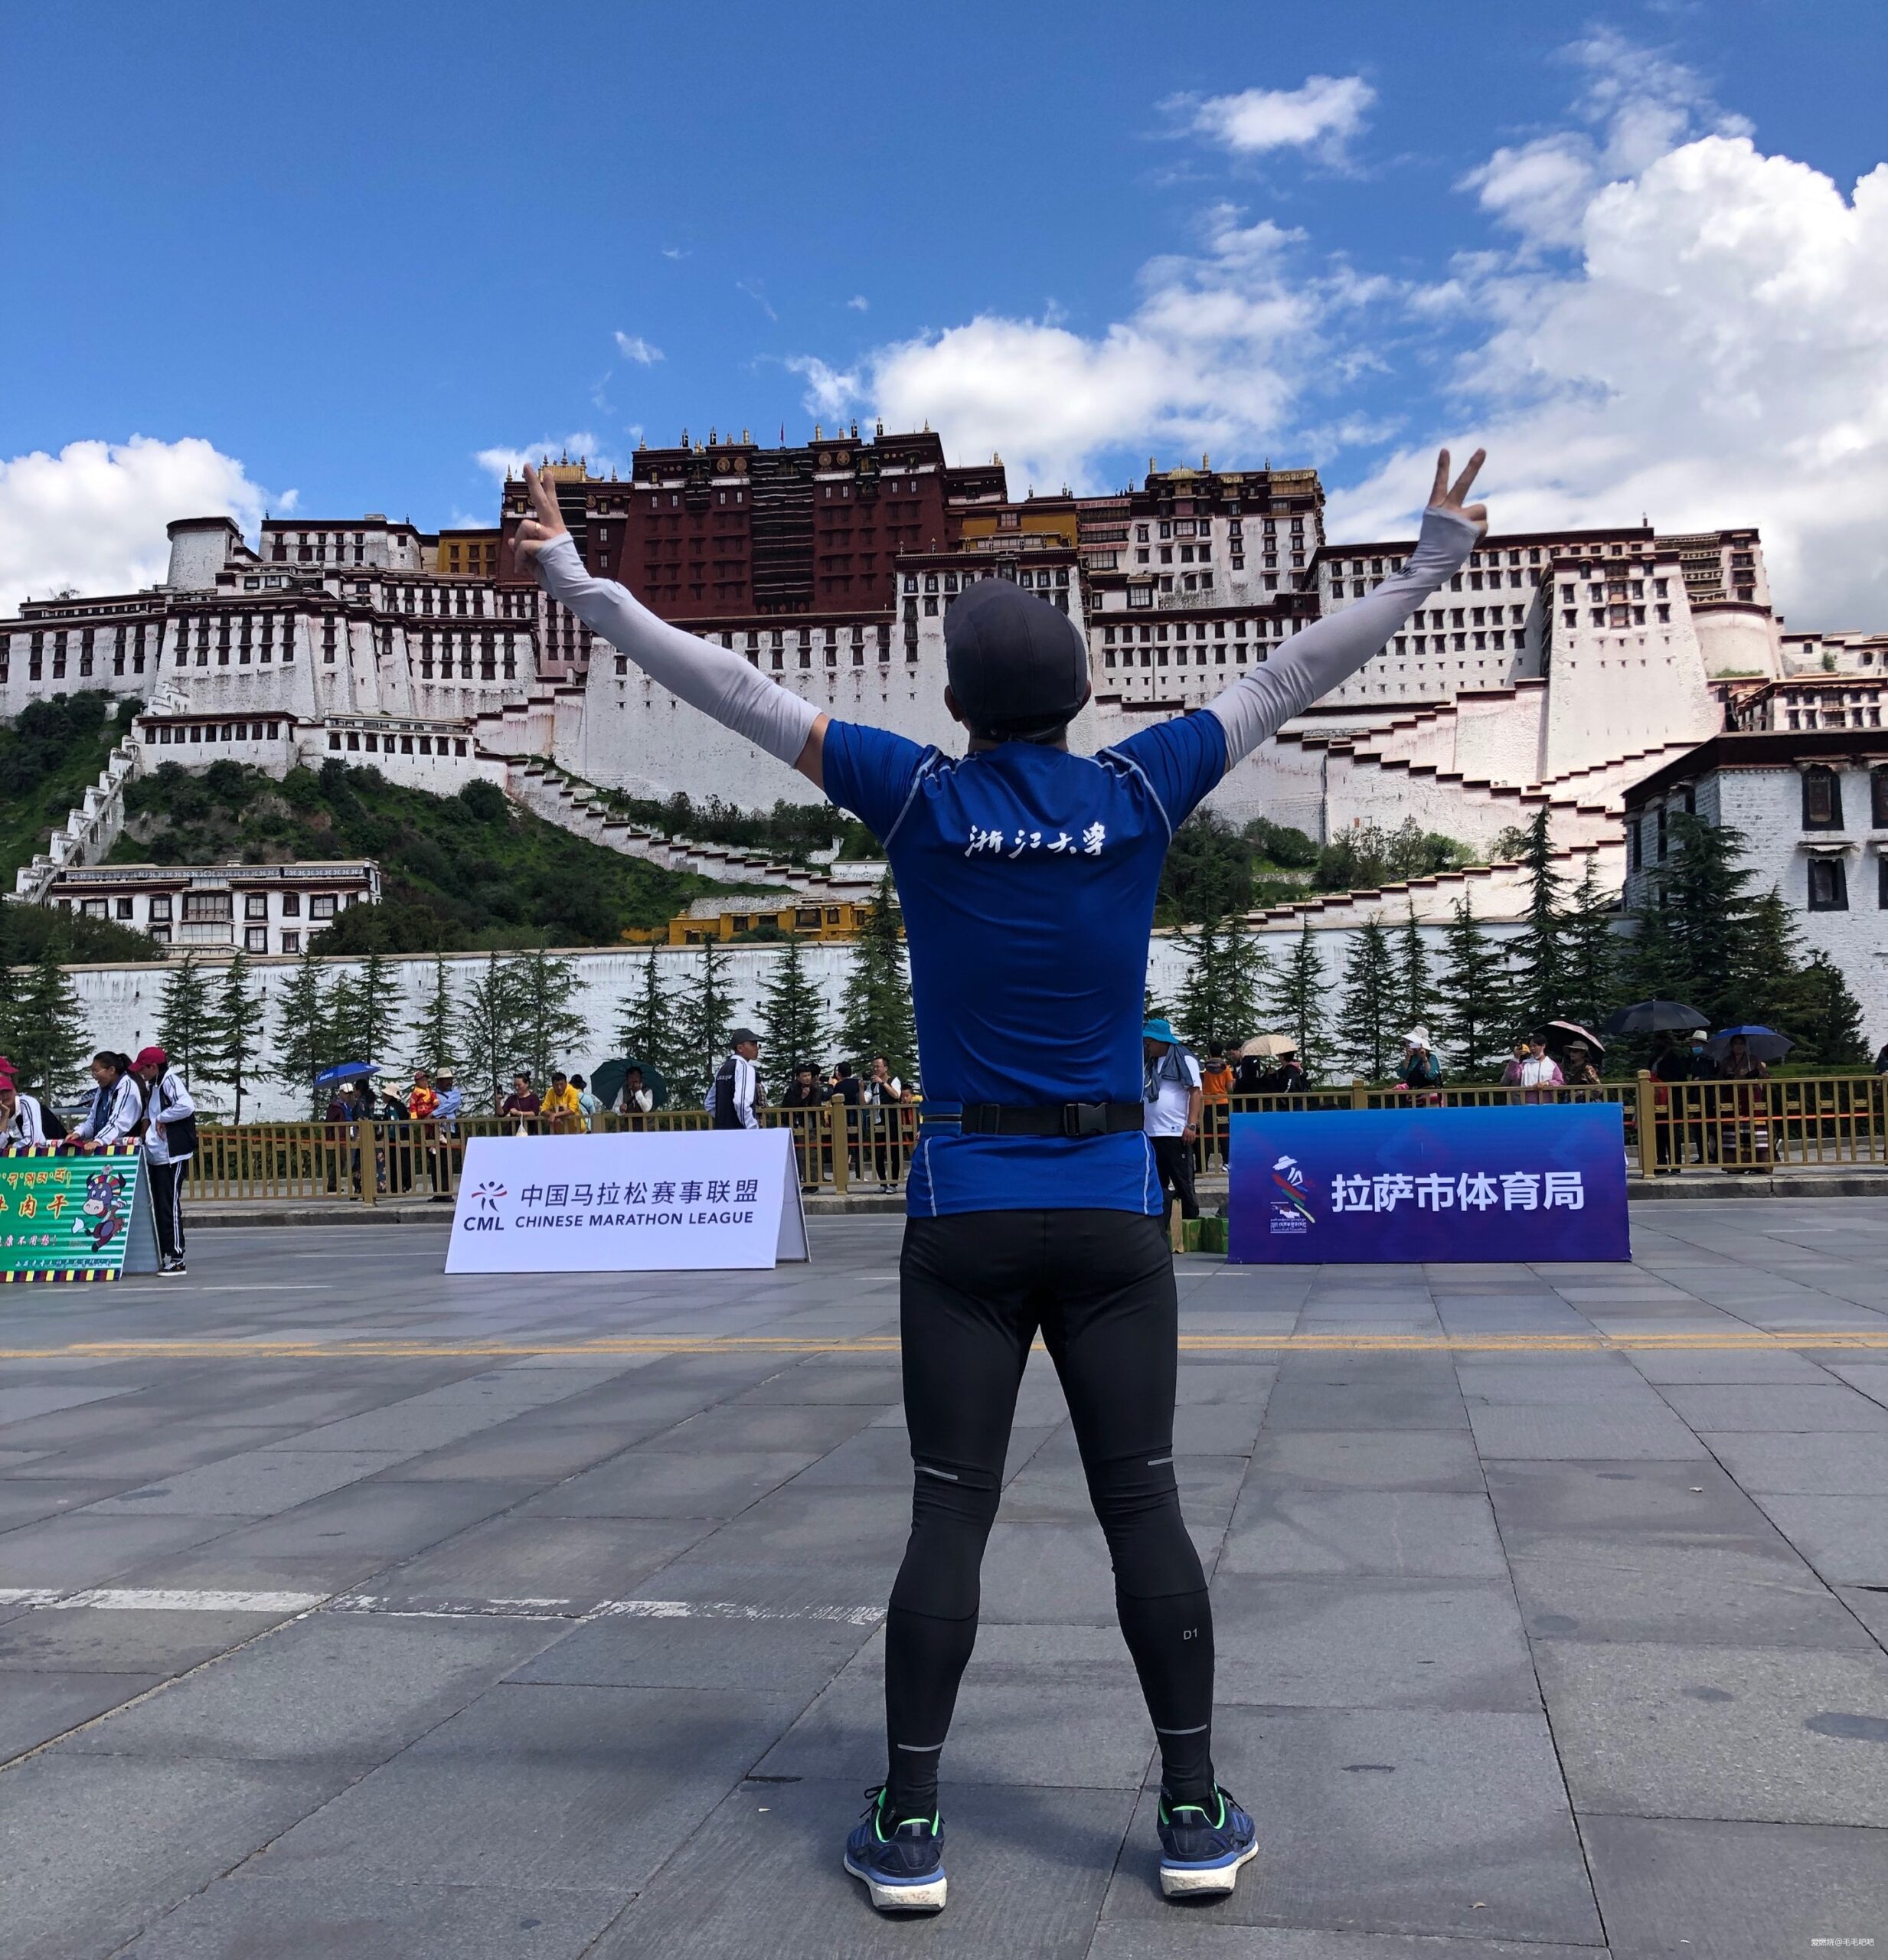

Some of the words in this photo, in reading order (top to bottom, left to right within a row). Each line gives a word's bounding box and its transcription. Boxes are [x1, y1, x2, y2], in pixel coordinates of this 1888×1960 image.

[521, 1179, 758, 1208] 中国马拉松赛事联盟
[1331, 1171, 1585, 1213] 拉萨市体育局
[463, 1217, 505, 1231] CML
[515, 1215, 583, 1228] CHINESE
[589, 1213, 683, 1227] MARATHON
[688, 1211, 753, 1224] LEAGUE
[1183, 1628, 1197, 1640] D1
